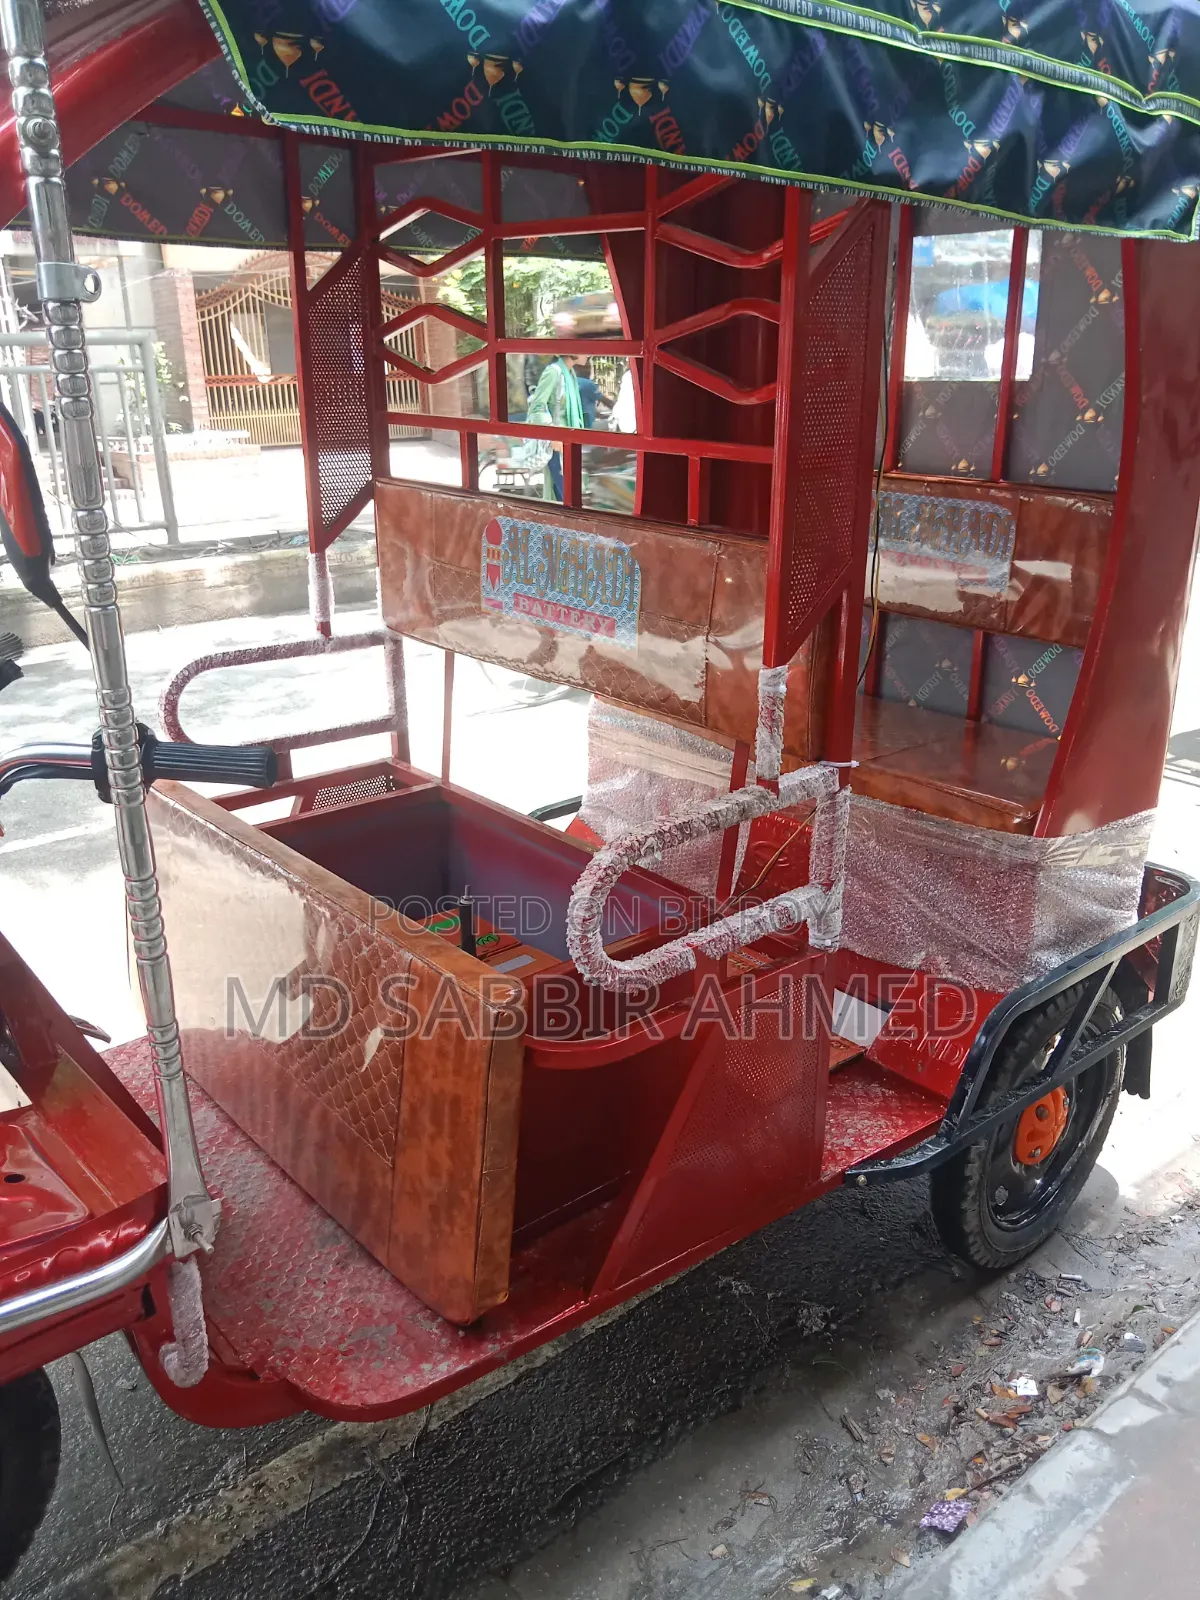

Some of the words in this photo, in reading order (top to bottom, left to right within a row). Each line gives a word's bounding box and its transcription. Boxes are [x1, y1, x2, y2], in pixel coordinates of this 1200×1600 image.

[440, 0, 491, 50] DOW
[721, 5, 772, 97] DOWEDO
[436, 80, 484, 131] DOW
[593, 101, 634, 143] DOW
[732, 118, 767, 161] DOW
[518, 596, 611, 634] BATTERY
